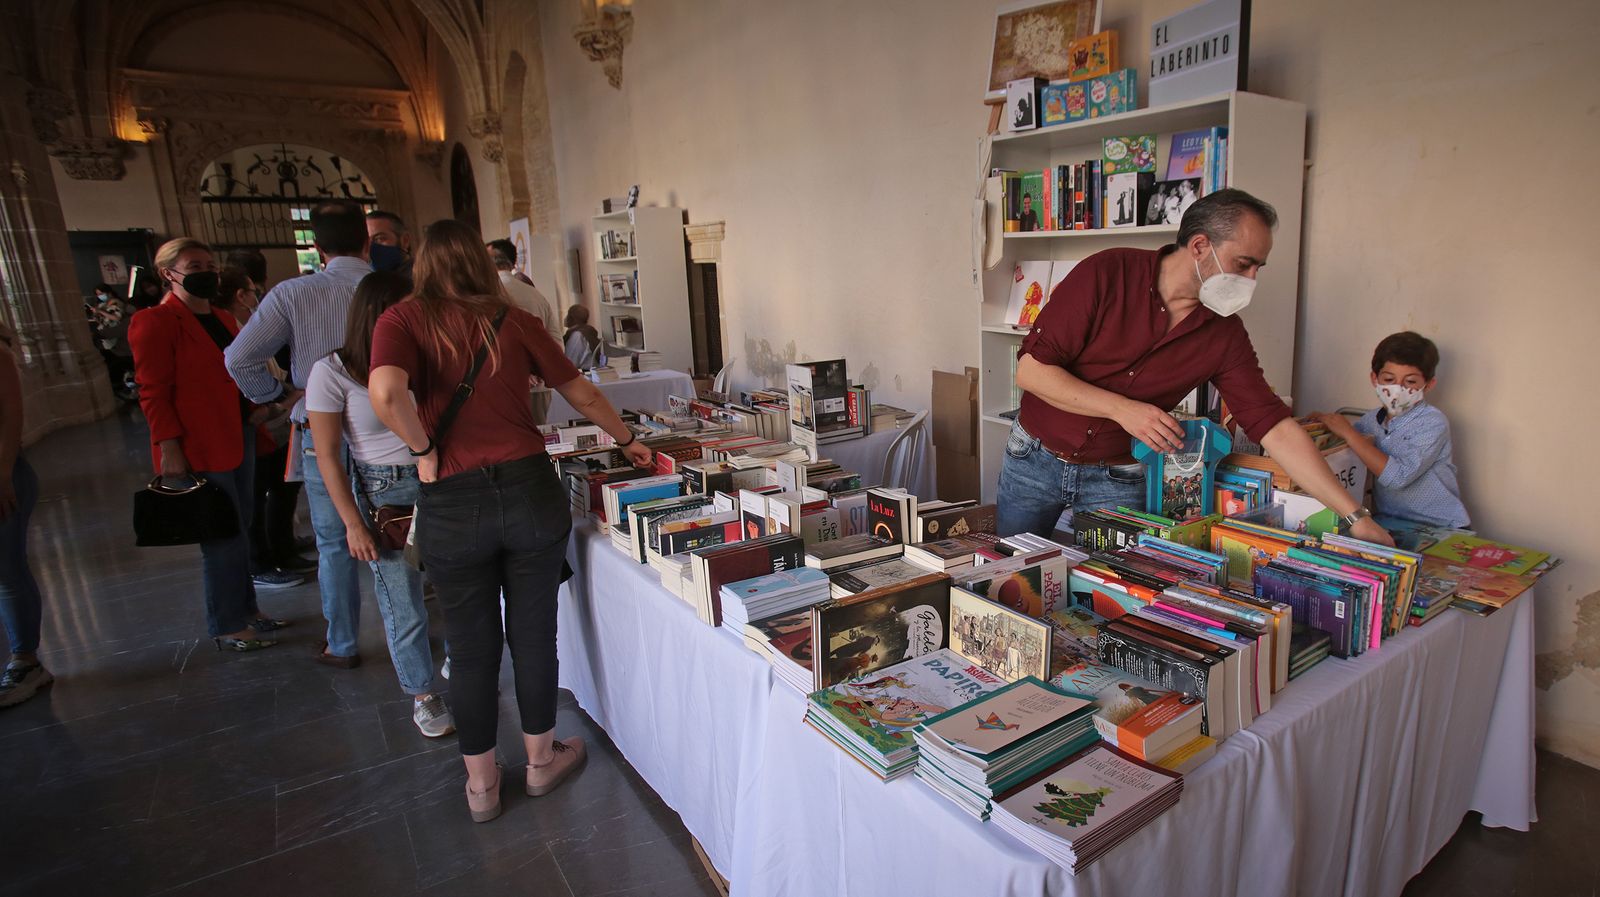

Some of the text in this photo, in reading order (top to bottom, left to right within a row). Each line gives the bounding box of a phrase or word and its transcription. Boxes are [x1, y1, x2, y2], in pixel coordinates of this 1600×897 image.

[1156, 25, 1168, 47] EL
[1151, 34, 1229, 78] LABERINTO
[870, 499, 895, 518] La Luz
[773, 556, 787, 574] TÁN
[917, 610, 936, 656] Galdó
